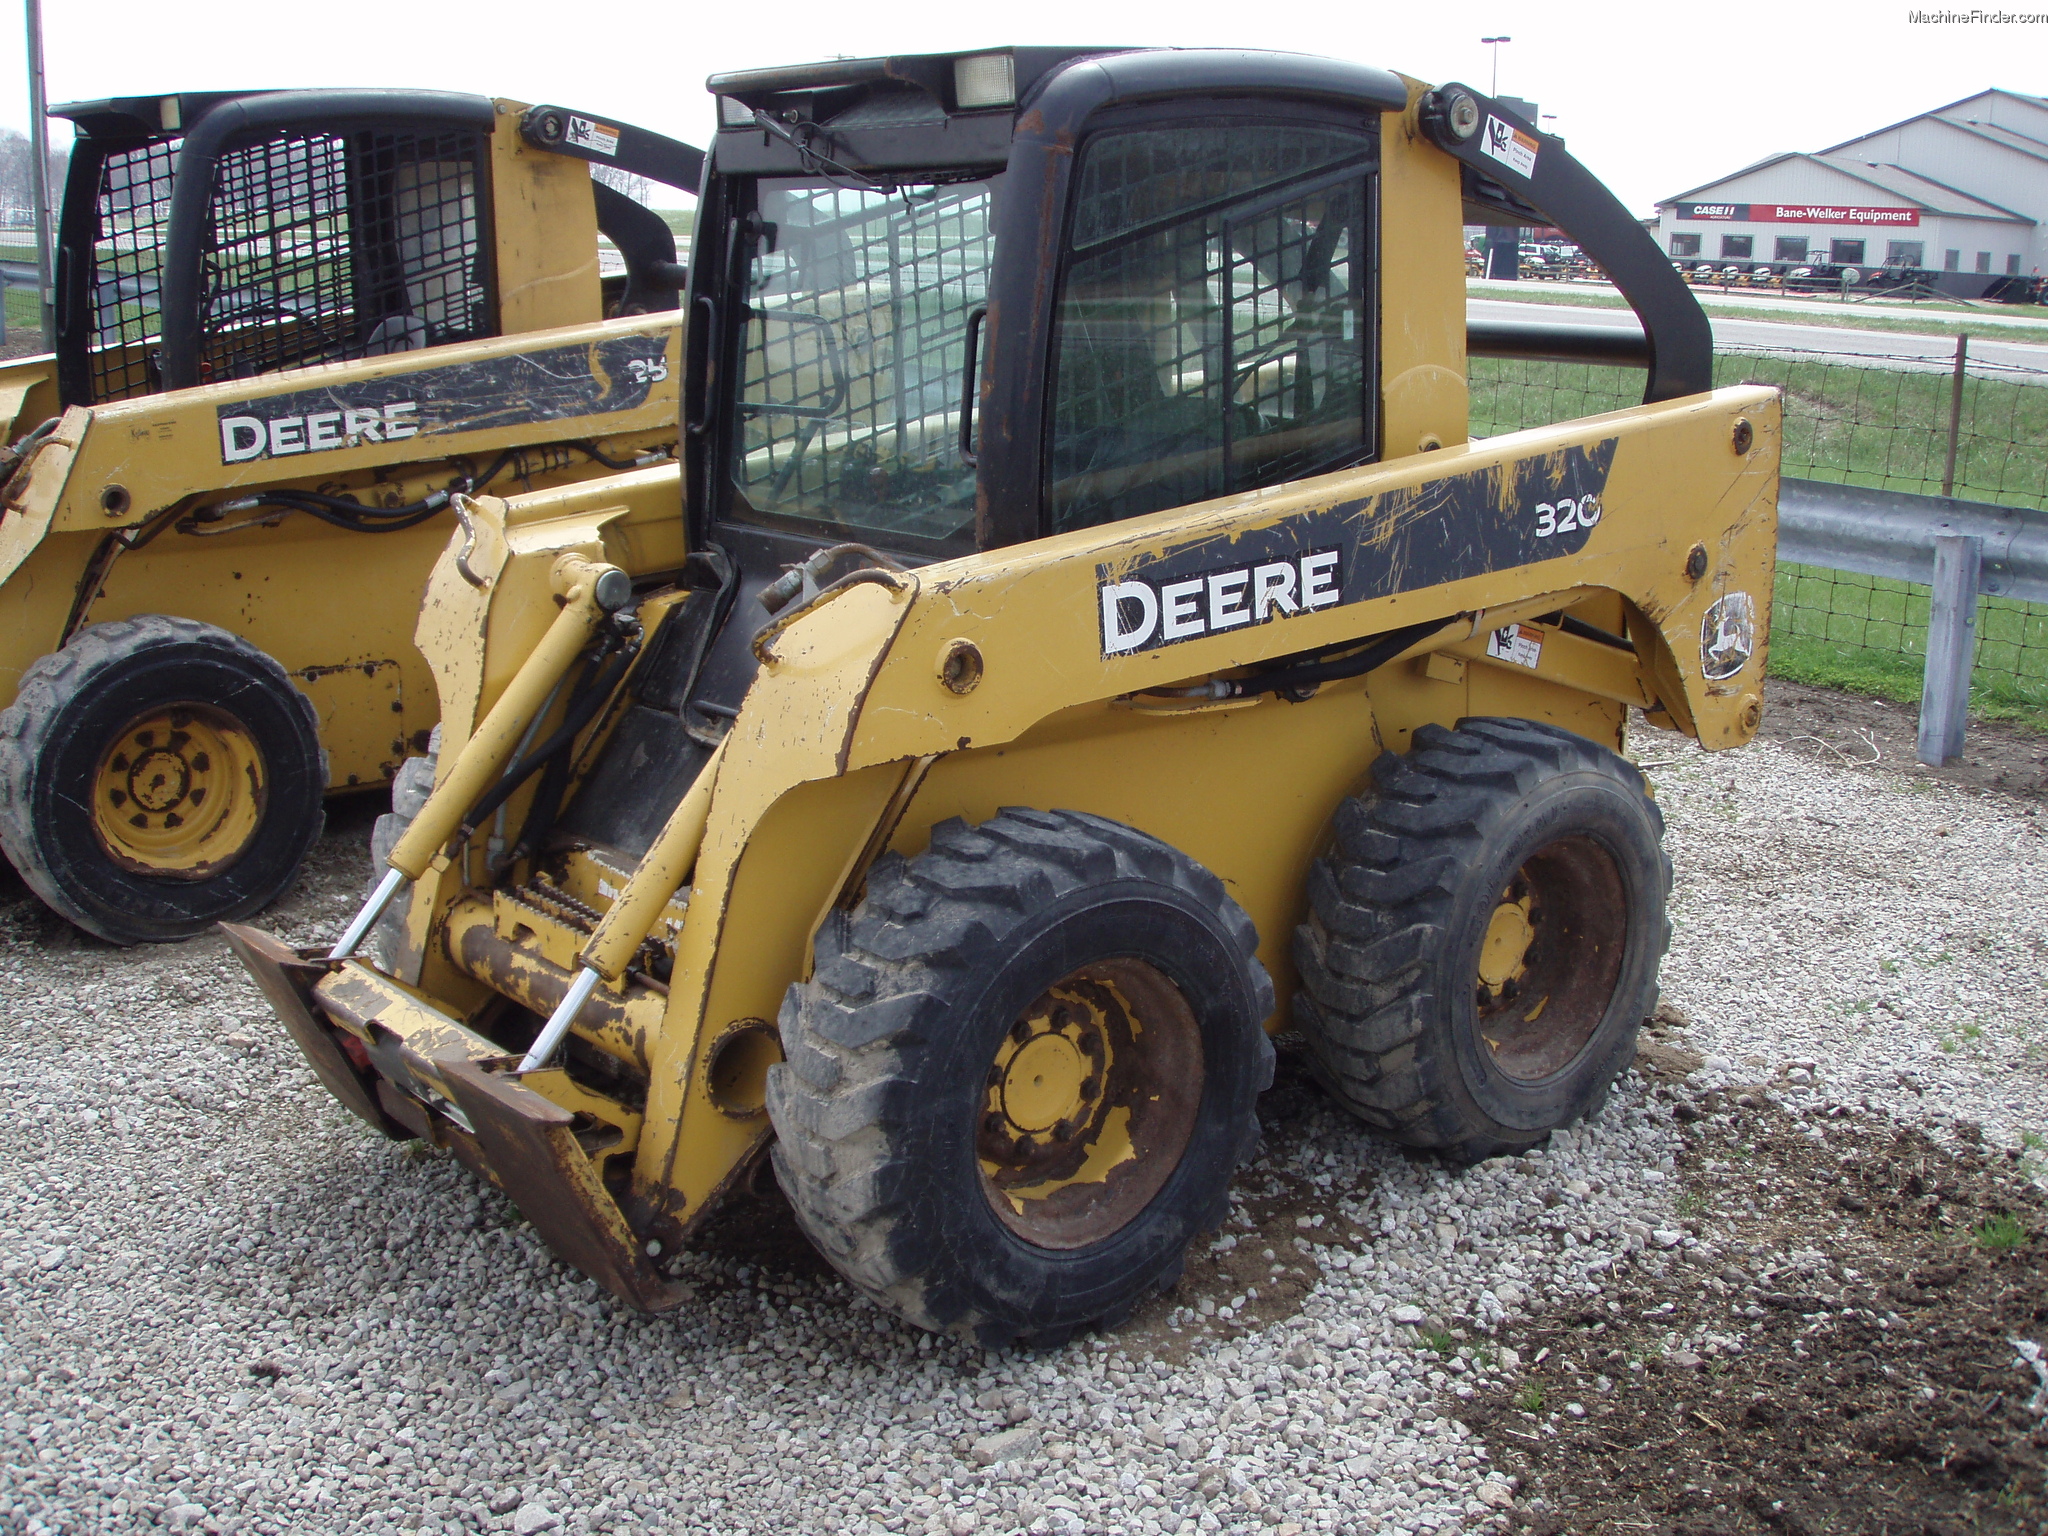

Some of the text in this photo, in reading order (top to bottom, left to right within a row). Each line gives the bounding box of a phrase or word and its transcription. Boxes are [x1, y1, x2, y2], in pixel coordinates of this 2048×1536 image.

[1776, 207, 1912, 223] Bane-Welker Equipment
[221, 401, 419, 462] DEERE
[1535, 493, 1601, 538] 320
[1102, 550, 1339, 655] DEERE
